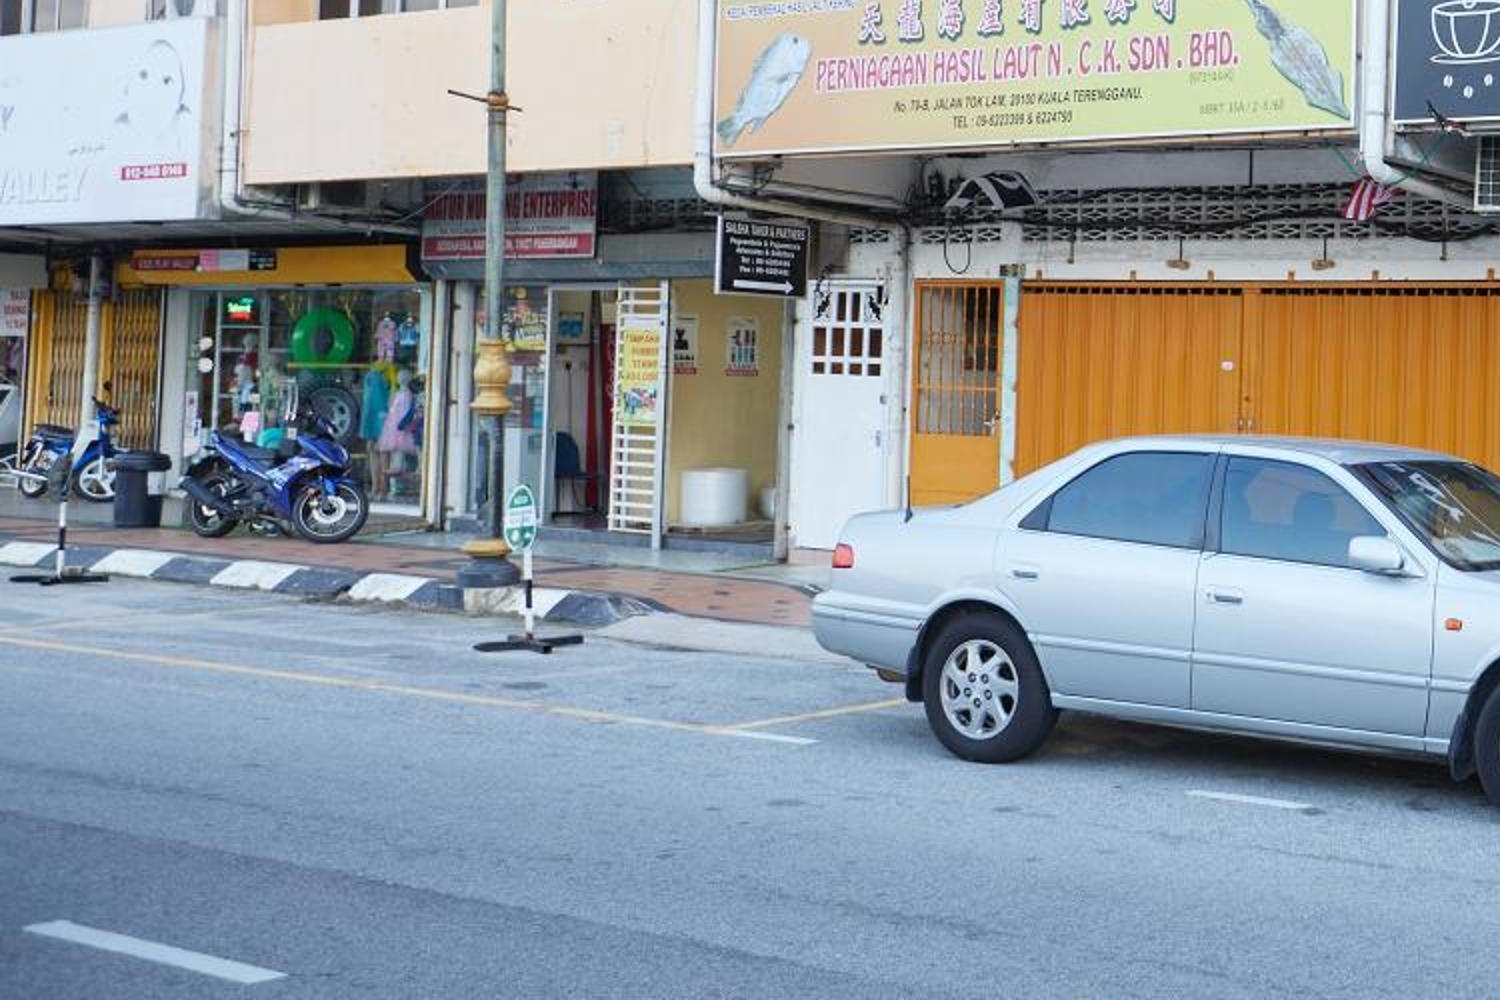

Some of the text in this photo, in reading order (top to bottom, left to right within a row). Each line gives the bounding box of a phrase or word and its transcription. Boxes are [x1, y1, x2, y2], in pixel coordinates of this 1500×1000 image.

[816, 53, 927, 92] PERNIAGAAN
[933, 48, 988, 86] HASIL
[993, 43, 1043, 81] LAUT
